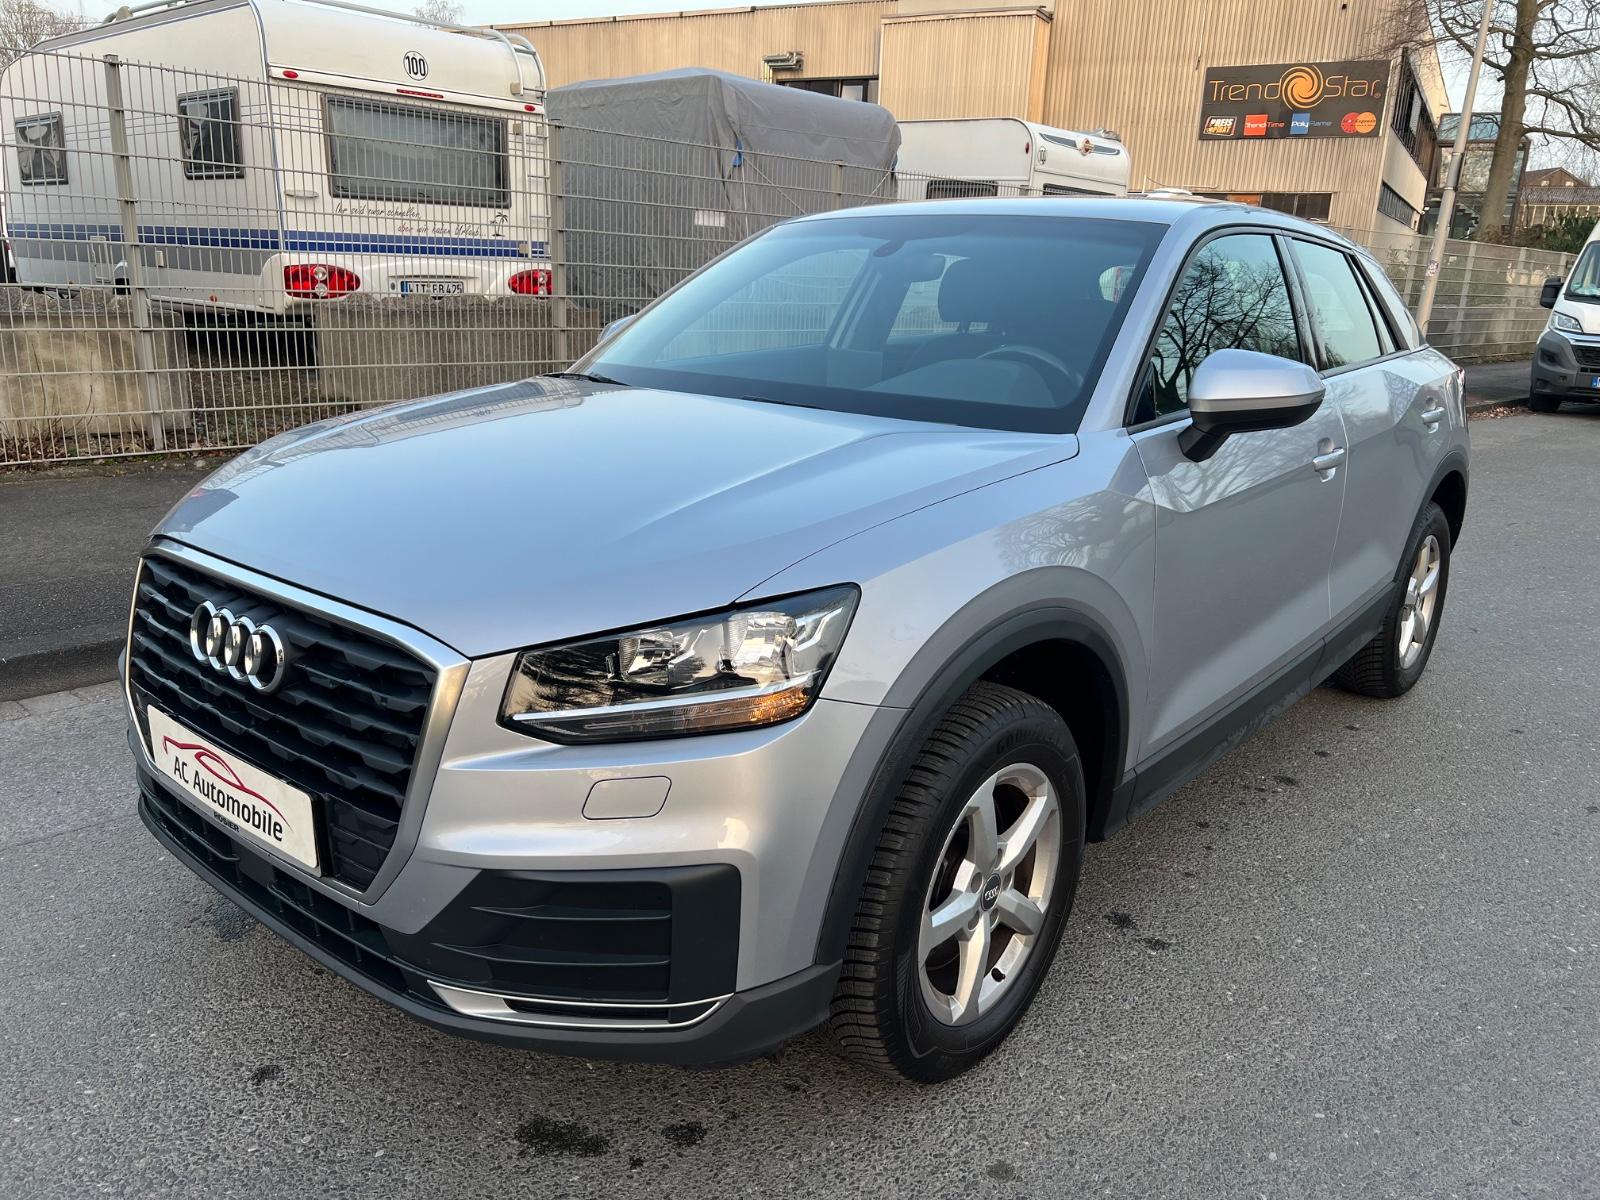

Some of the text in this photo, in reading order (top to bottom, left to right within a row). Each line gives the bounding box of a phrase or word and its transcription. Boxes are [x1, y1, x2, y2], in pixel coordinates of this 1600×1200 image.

[405, 55, 426, 76] 100
[1209, 75, 1380, 101] Trend Star
[174, 756, 283, 842] AC Automobile
